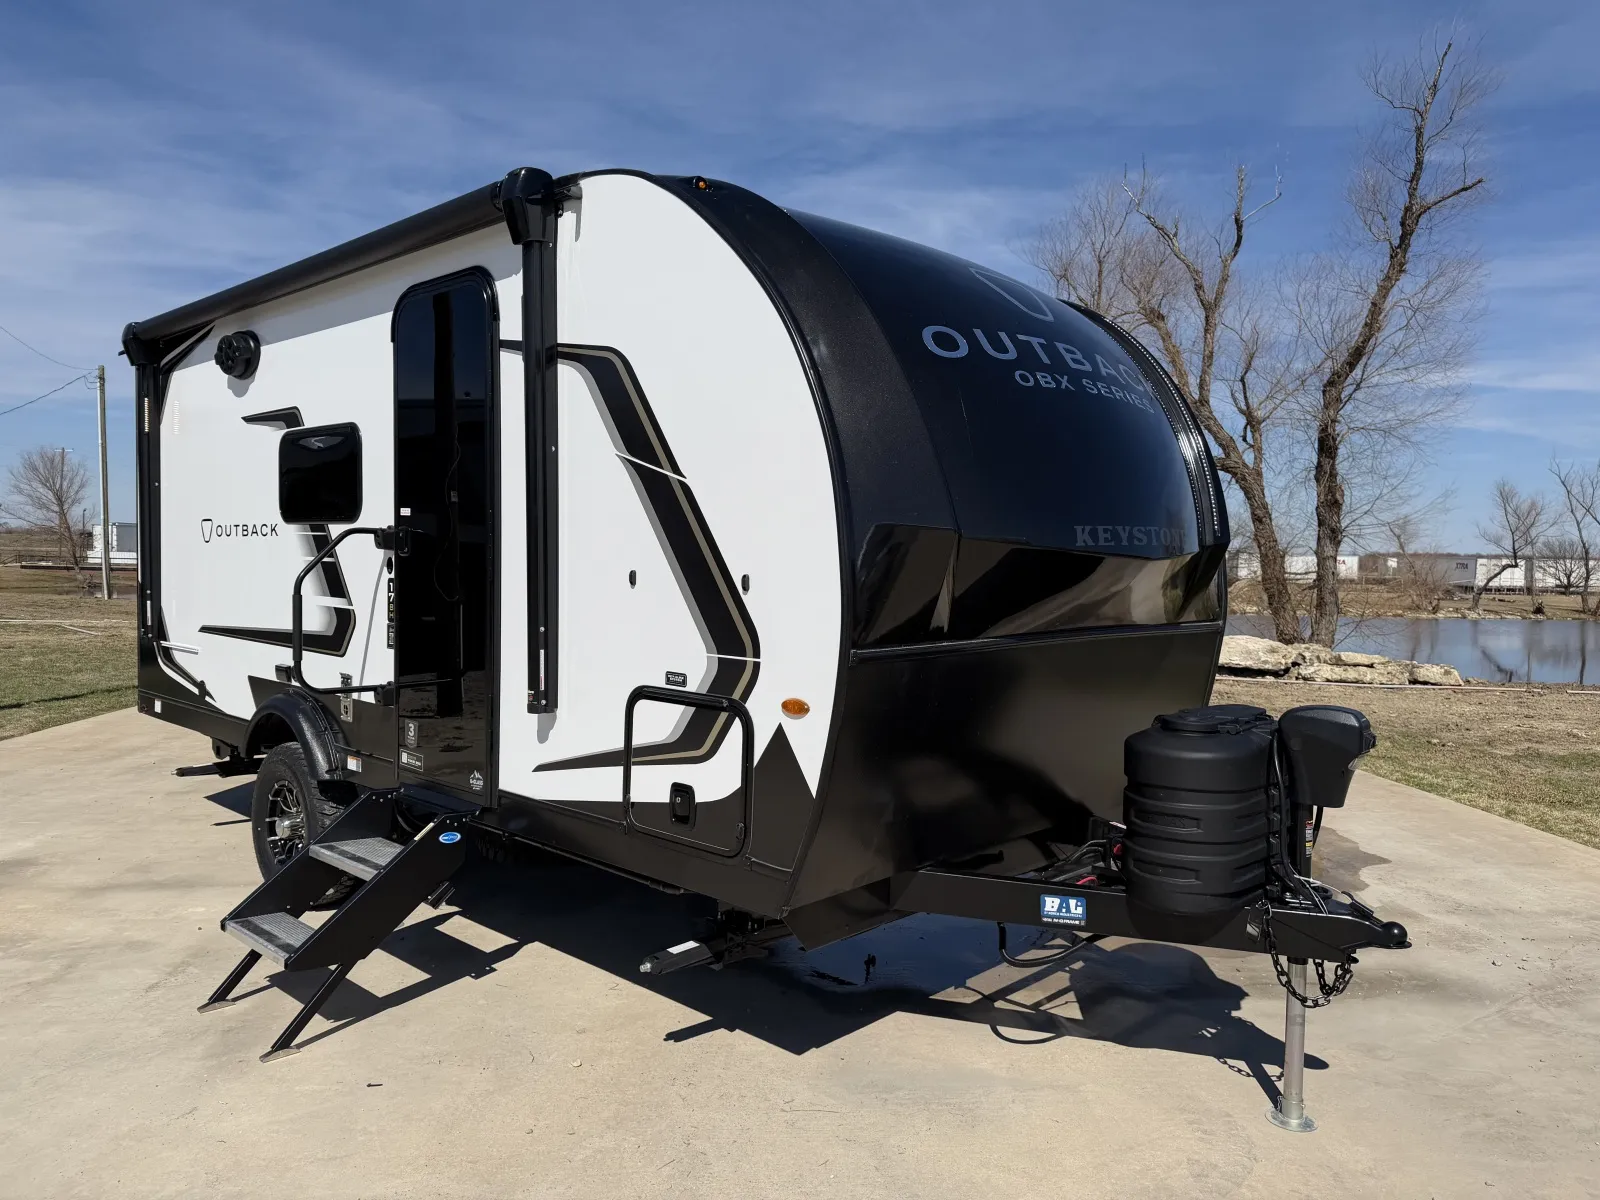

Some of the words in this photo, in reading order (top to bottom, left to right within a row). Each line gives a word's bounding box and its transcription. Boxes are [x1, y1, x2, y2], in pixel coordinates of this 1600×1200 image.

[1014, 370, 1075, 391] OBX
[1082, 378, 1155, 414] SERIES
[216, 523, 279, 537] OUTBACK
